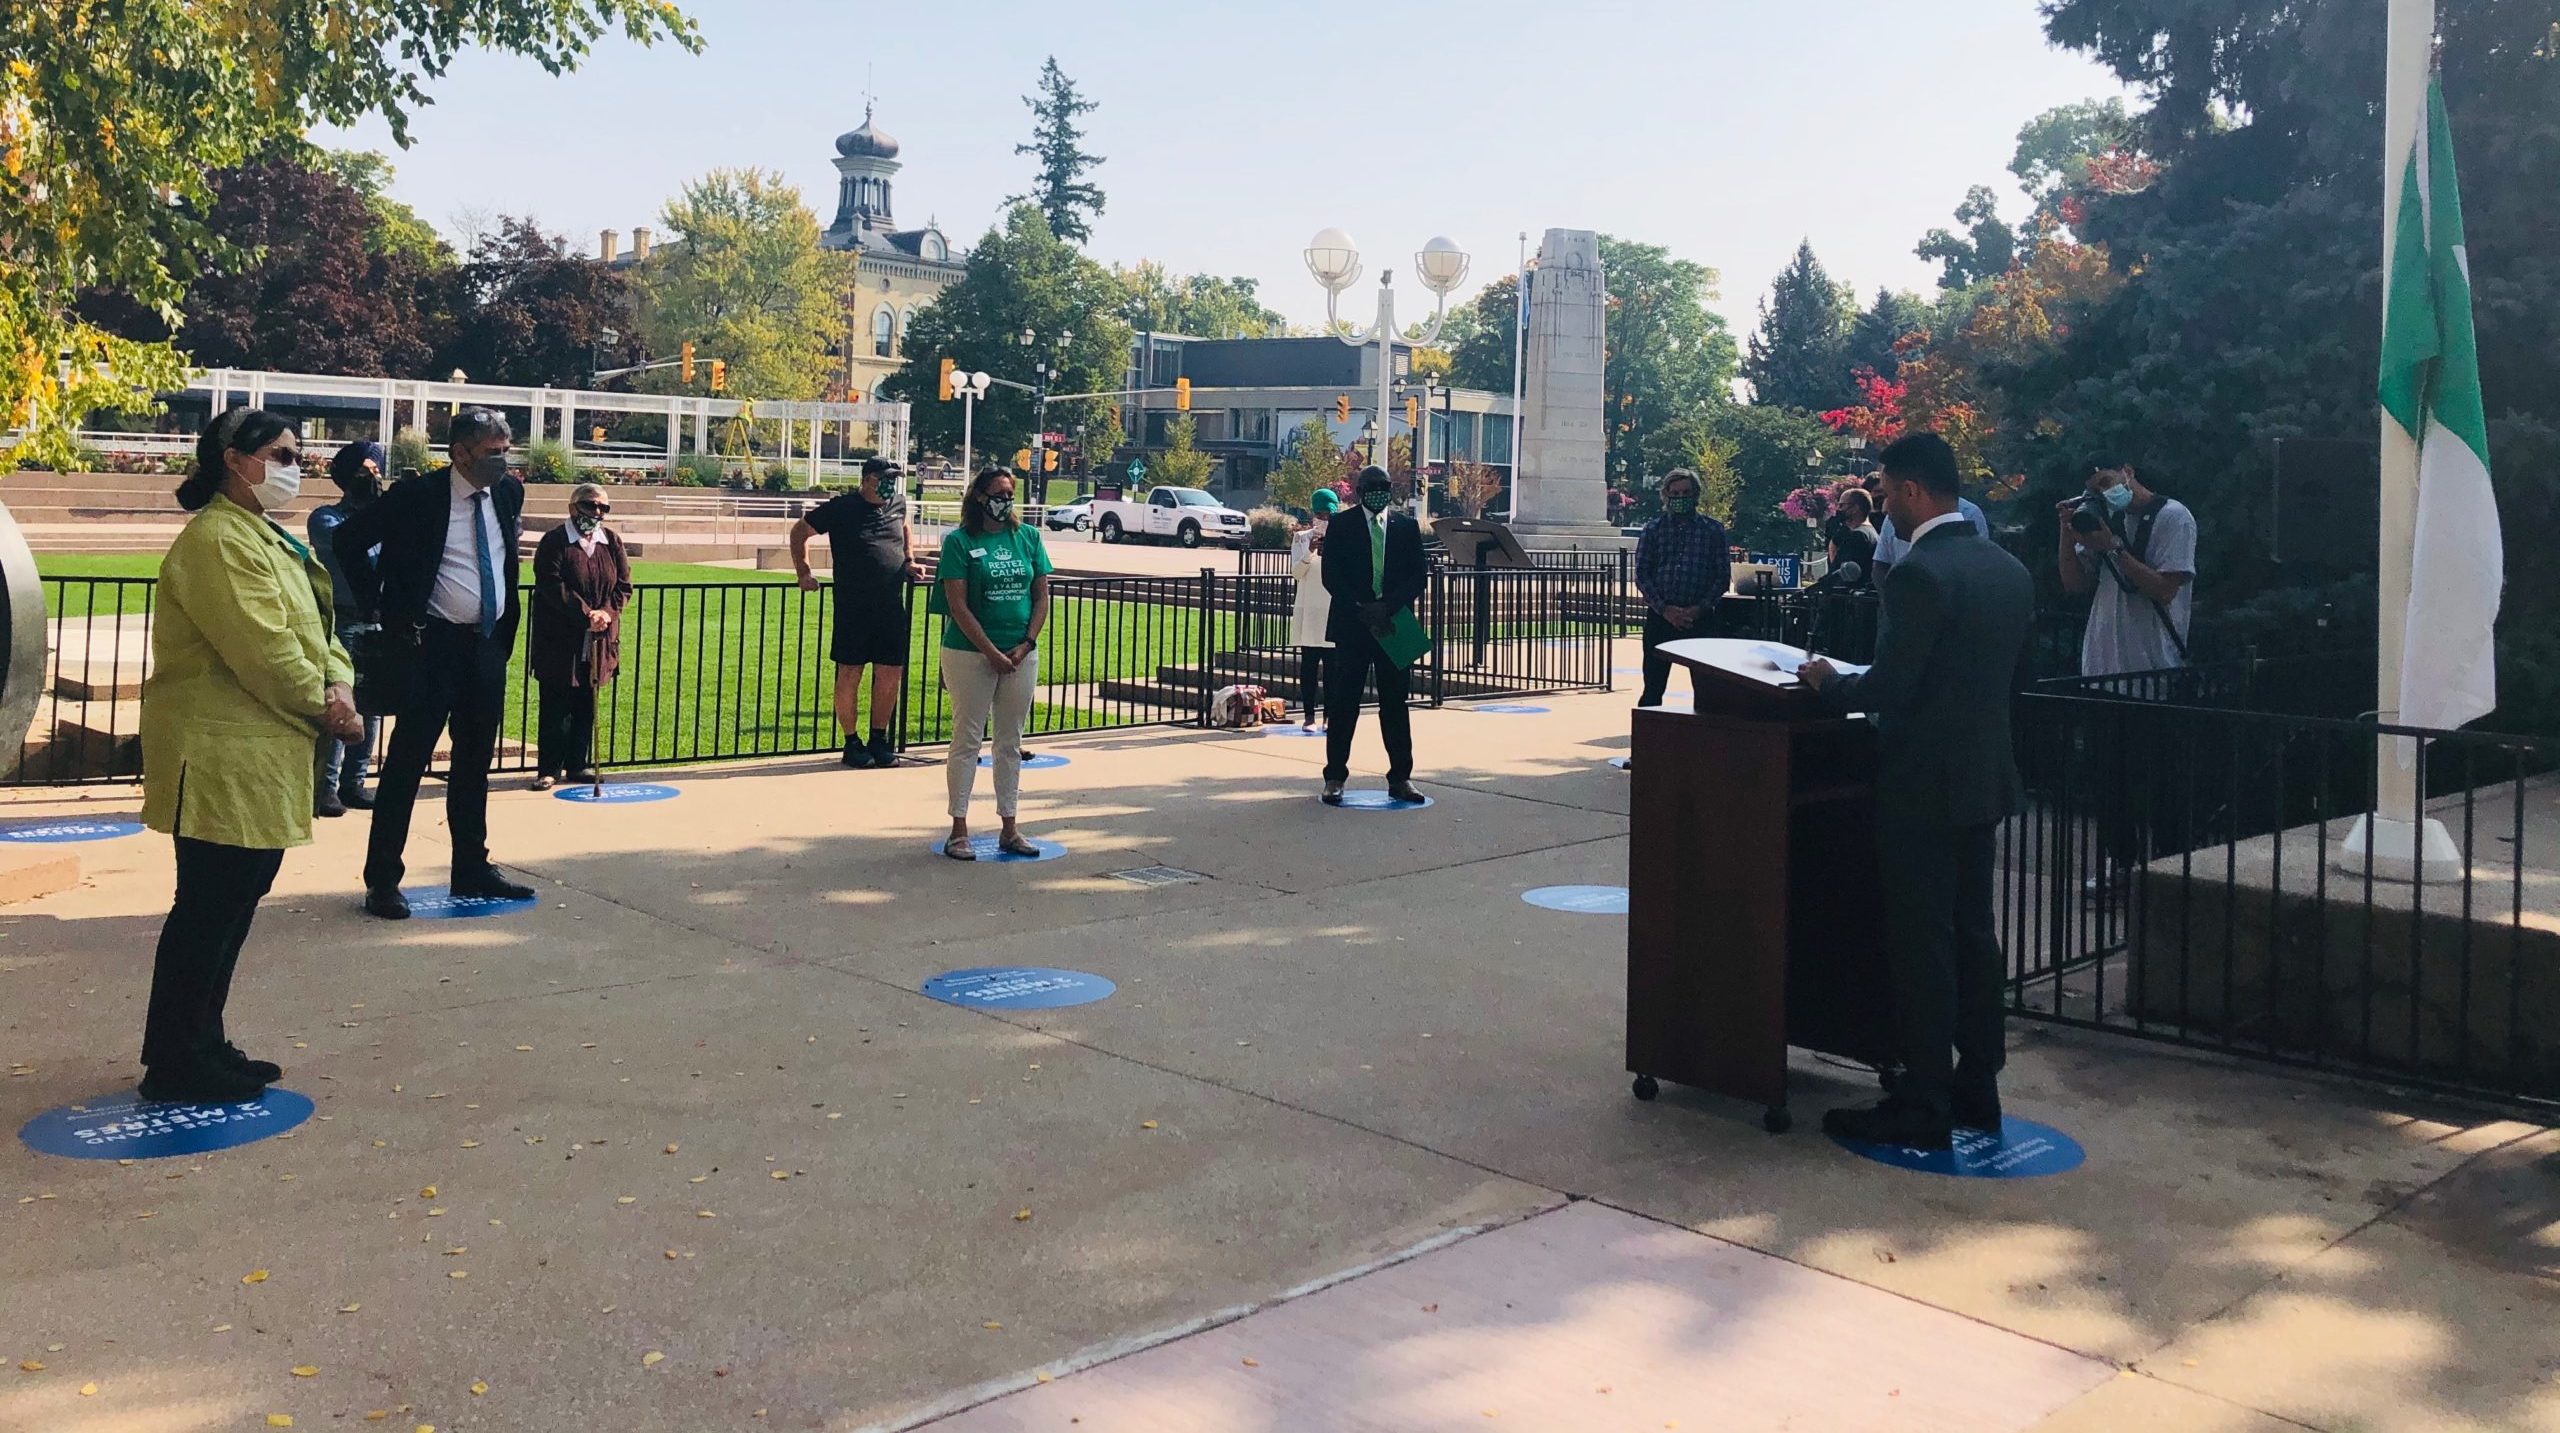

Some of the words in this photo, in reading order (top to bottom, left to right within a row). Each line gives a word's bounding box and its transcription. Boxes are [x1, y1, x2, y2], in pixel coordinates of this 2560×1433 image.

[988, 560, 1024, 569] RESTEZ
[1767, 558, 1791, 567] EXIT
[990, 568, 1026, 577] CALME
[1779, 576, 1791, 584] AY
[236, 1102, 262, 1111] 2
[122, 1105, 198, 1123] APART
[73, 1107, 225, 1139] METRES
[180, 1109, 272, 1130] PLEASE
[85, 1126, 174, 1145] STAND
